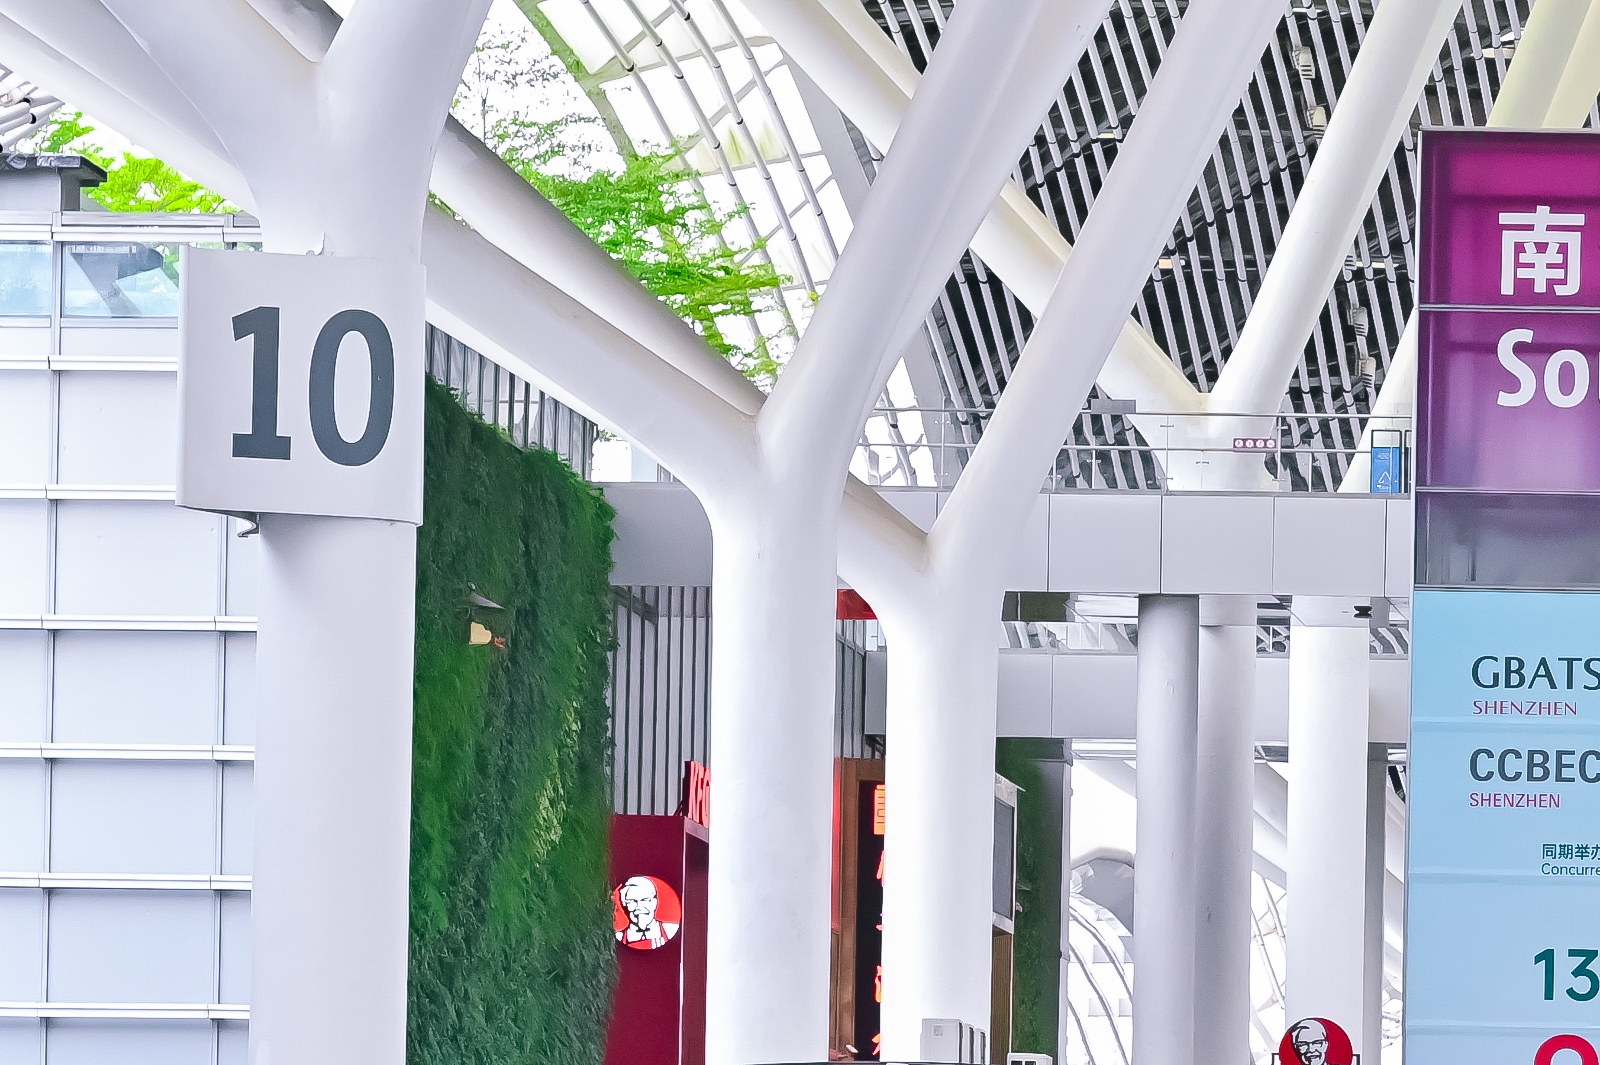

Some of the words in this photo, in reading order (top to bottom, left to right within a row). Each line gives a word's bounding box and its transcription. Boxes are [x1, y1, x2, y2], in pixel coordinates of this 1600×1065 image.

[230, 304, 396, 467] 10
[1472, 700, 1577, 716] SHENZHEN
[1469, 792, 1560, 808] SHENZHEN
